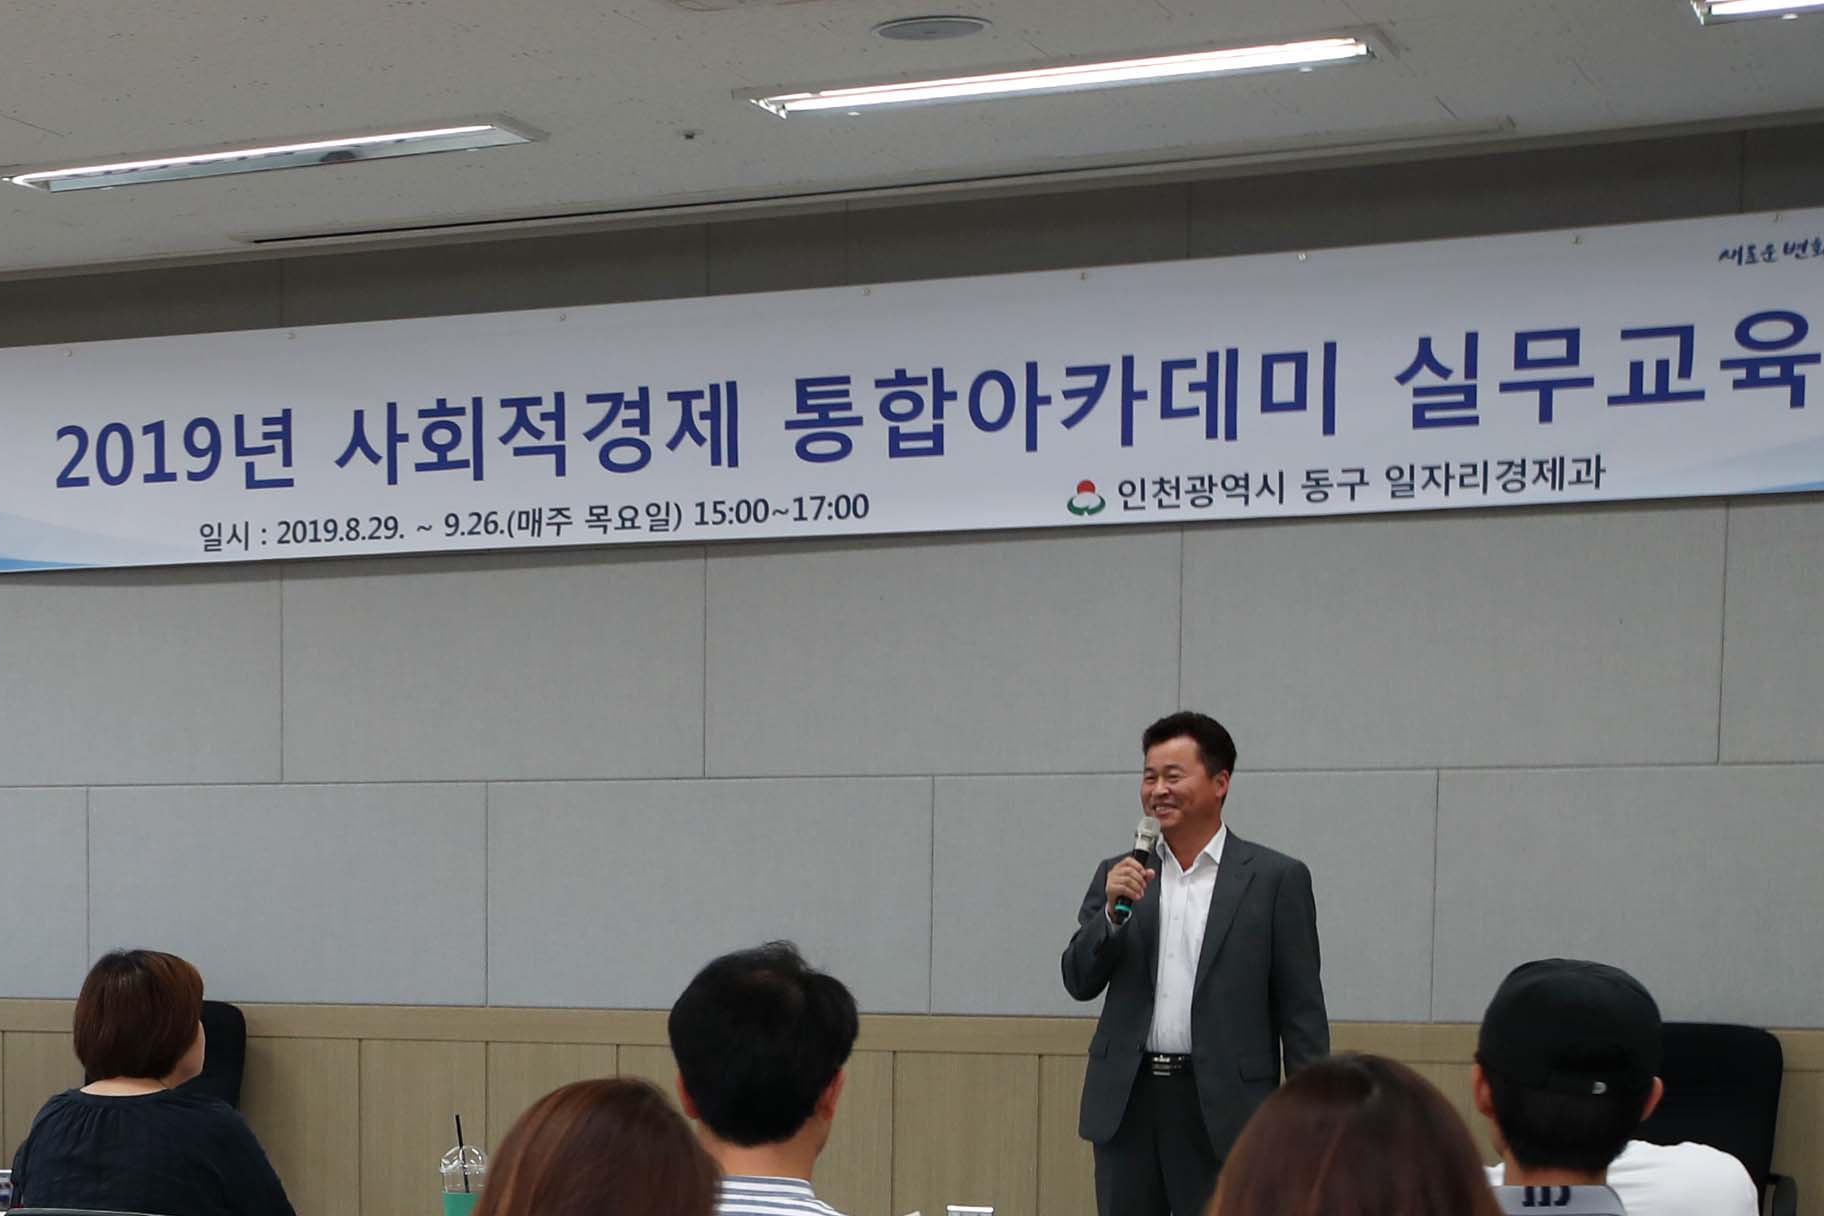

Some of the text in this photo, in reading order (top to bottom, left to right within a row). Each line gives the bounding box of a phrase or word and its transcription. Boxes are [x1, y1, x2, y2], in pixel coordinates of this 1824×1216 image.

[55, 309, 1823, 490] 2019년 사회적경제 통합아카데미 실무교육
[1116, 452, 1607, 514] 인천광역시 동구 일자리경제과
[198, 520, 251, 553] 일시
[275, 515, 406, 545] 2019.8.29.
[443, 506, 574, 540] 9.26.(매주
[583, 500, 683, 536] 목요일)
[693, 492, 870, 527] 15:00~17:00
